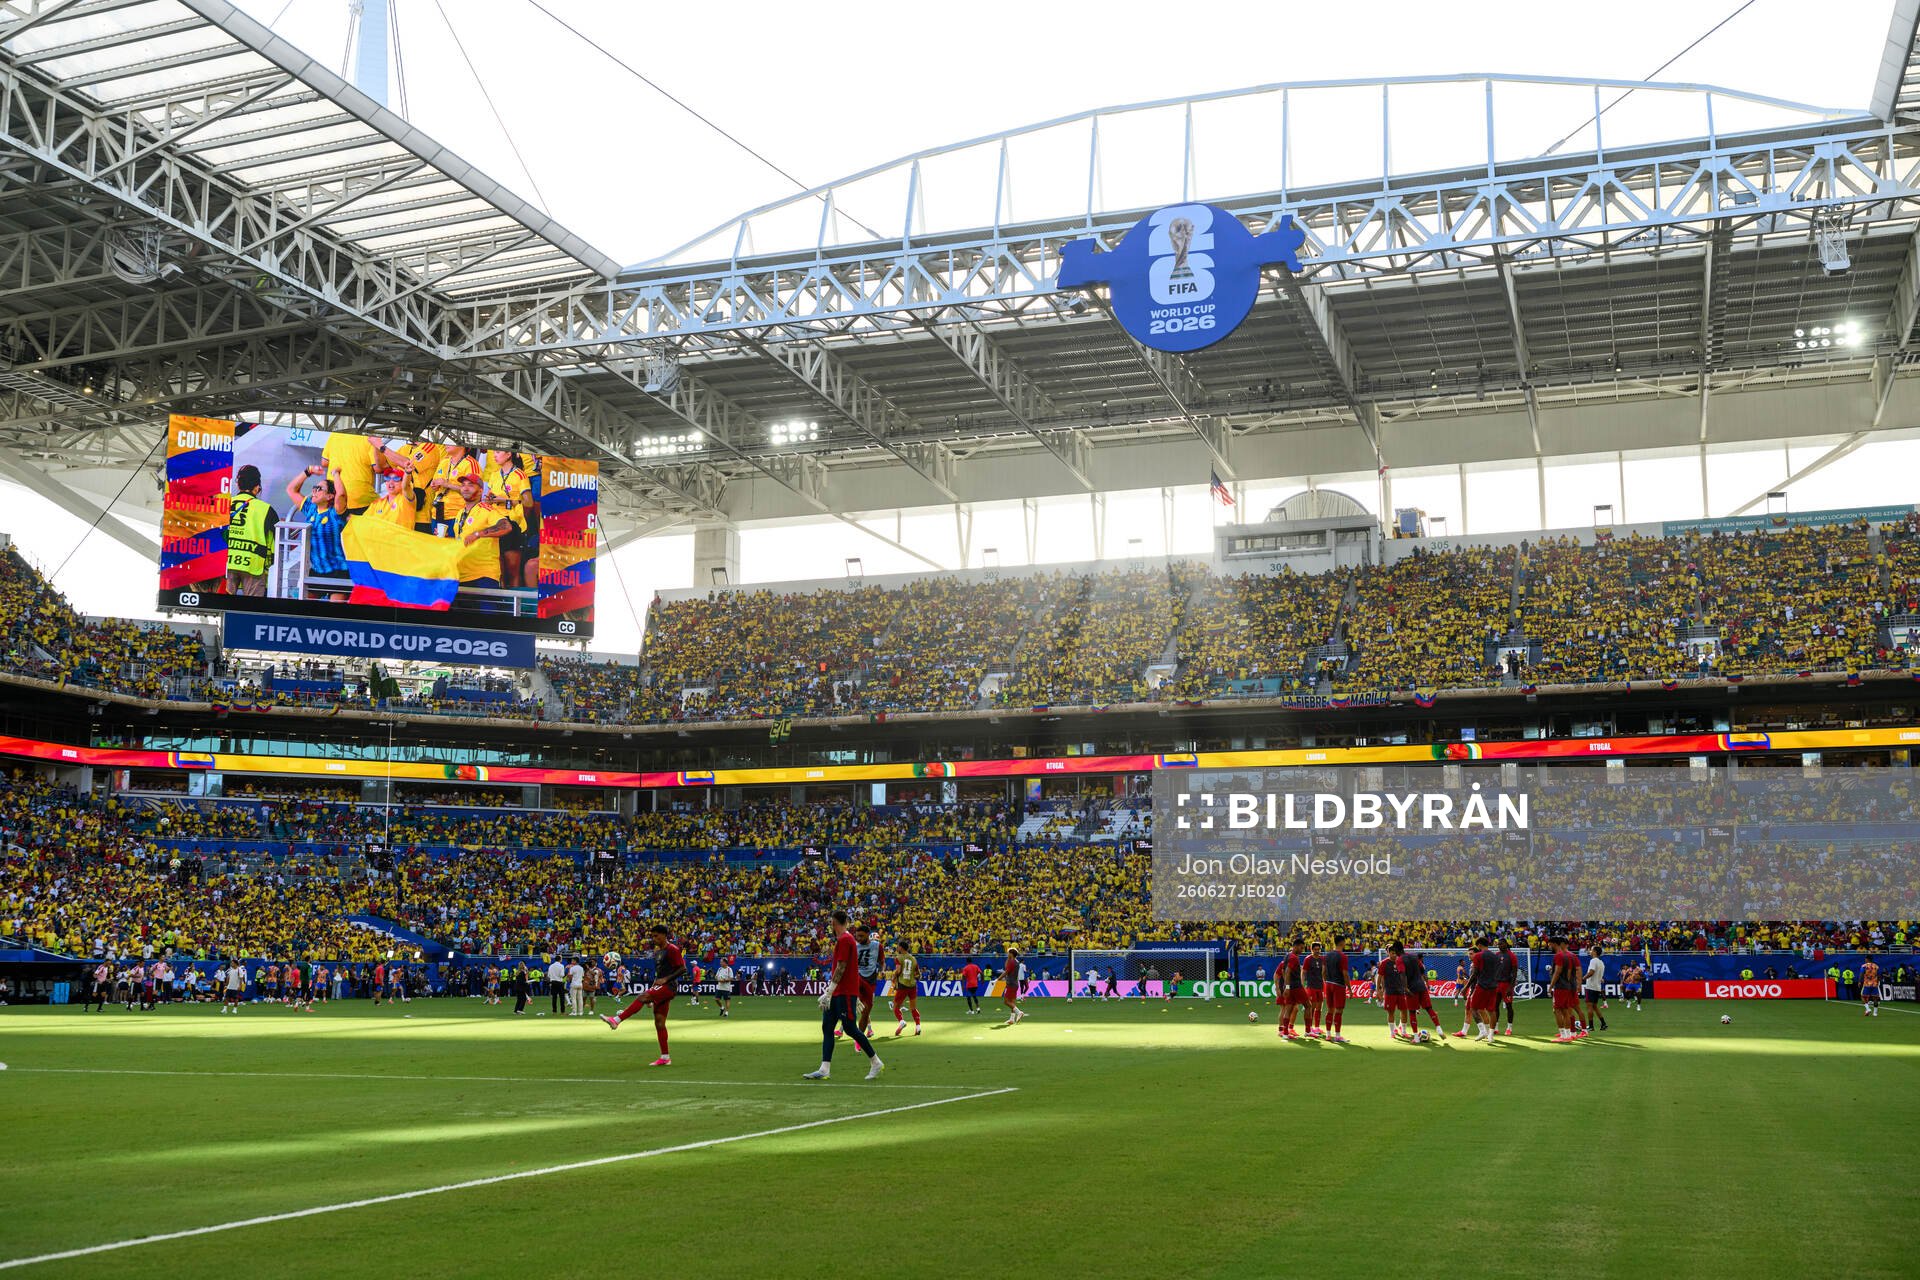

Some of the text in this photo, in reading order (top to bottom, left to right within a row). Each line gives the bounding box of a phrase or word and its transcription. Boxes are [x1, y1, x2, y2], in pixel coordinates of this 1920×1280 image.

[1168, 282, 1198, 295] FIFA
[1150, 304, 1216, 319] WORLD CUP
[1150, 315, 1216, 335] 2026
[290, 428, 312, 443] 347
[1430, 541, 1449, 550] 305
[983, 571, 1000, 580] 302
[180, 594, 198, 604] CC
[143, 620, 163, 631] 352
[560, 622, 574, 632] CC
[254, 624, 508, 658] FIFA WORLD CUP 2026
[576, 651, 593, 661] 355
[1296, 695, 1328, 708] FIEBRE
[920, 980, 964, 997] VISA
[1705, 982, 1782, 998] Lenovo
